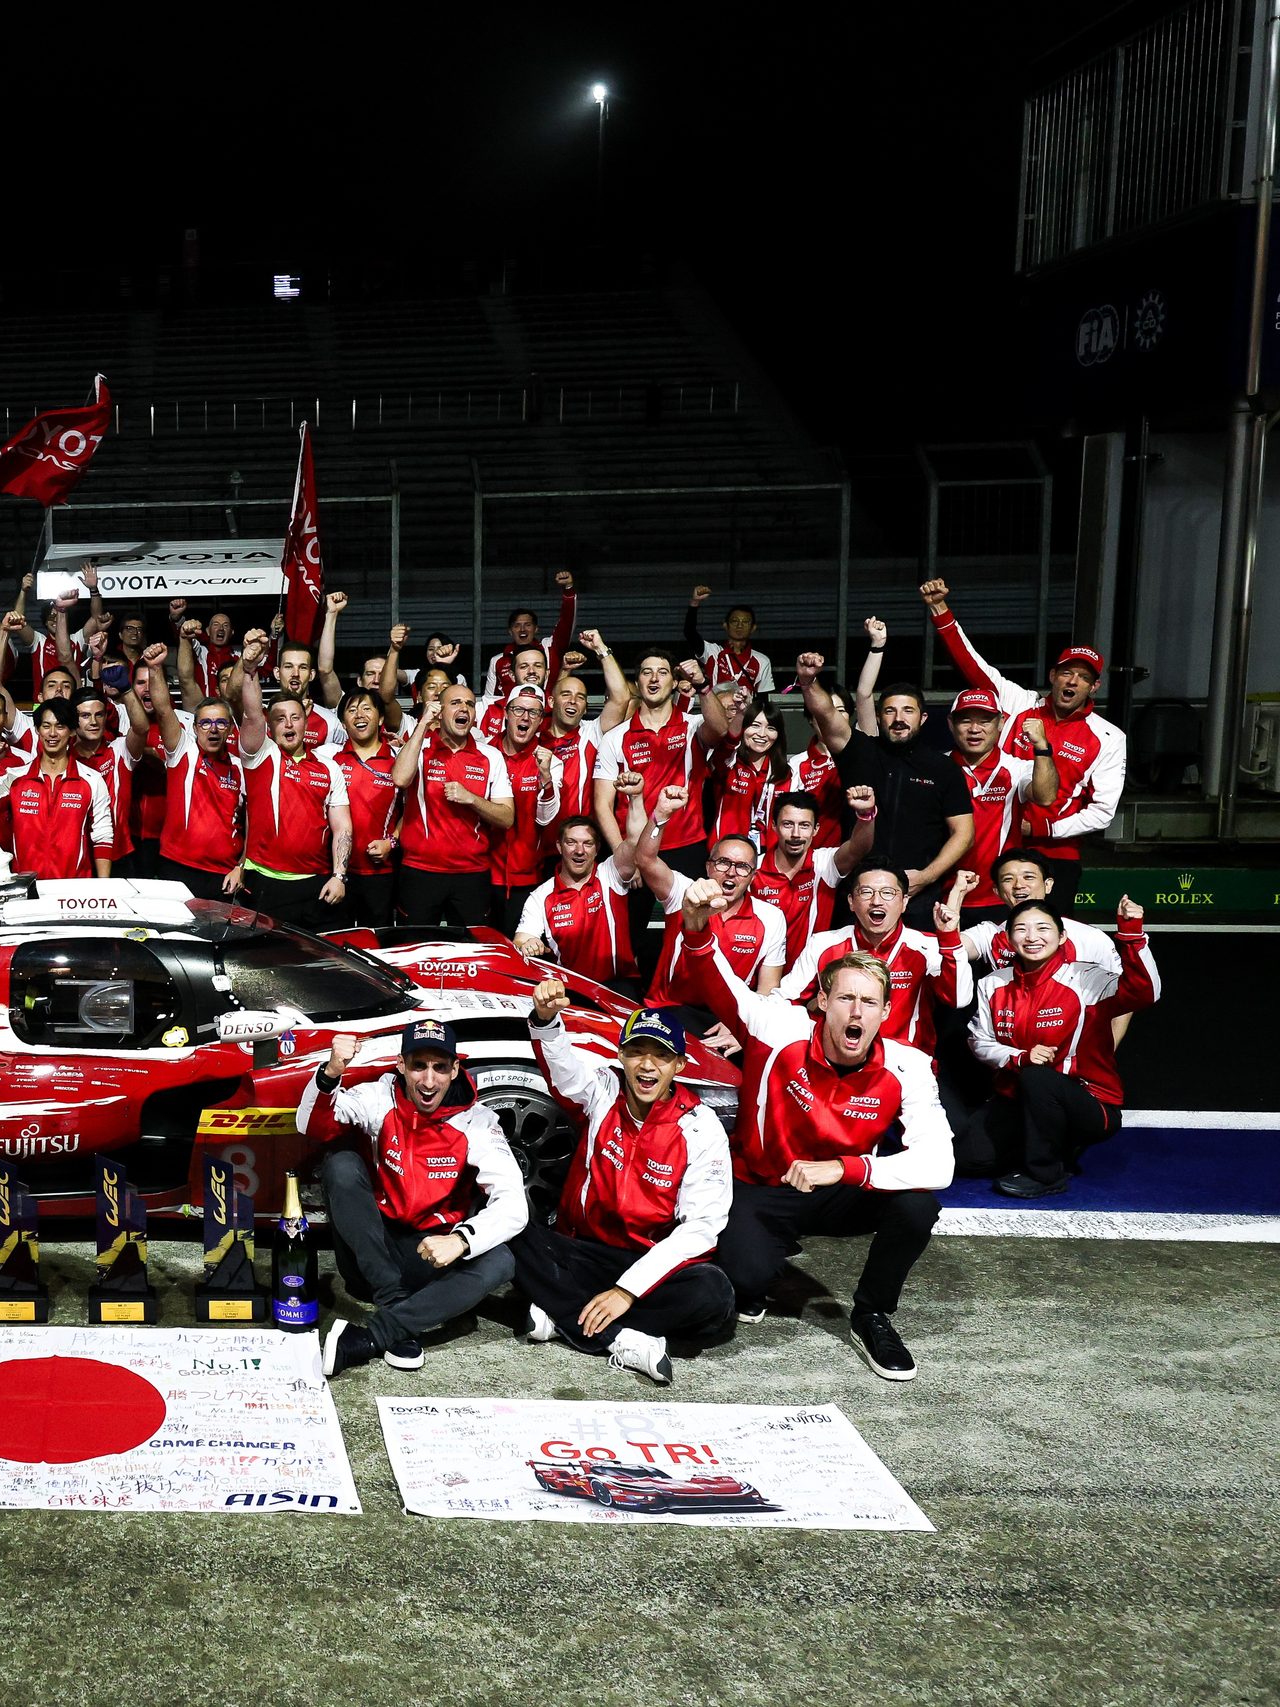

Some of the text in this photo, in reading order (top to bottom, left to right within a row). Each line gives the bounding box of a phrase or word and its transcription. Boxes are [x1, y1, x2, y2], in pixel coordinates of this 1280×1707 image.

[169, 577, 266, 586] RACING
[1070, 648, 1099, 660] TOYOTA
[962, 694, 989, 702] TOYOTA
[629, 741, 650, 751] FUJITSU
[1062, 740, 1086, 752] TOYOTA
[631, 750, 651, 758] AISIN
[1057, 751, 1082, 762] DENSO
[632, 758, 647, 766] Mobil
[465, 773, 485, 782] DENSO
[309, 780, 329, 788] DENSO
[373, 779, 394, 787] DENSO
[21, 788, 40, 799] FUJITSU
[20, 800, 39, 808] AISIN
[757, 886, 779, 896] FUJITSU
[1155, 893, 1214, 904] ROLEX
[57, 898, 117, 910] TOYOTA
[551, 903, 571, 913] FUJITSU
[734, 933, 757, 942] TOYOTA
[731, 946, 755, 954] DENSO
[417, 961, 478, 978] TOYOTA 8
[223, 1022, 274, 1035] DENSO
[632, 1018, 672, 1035] MICHELIN
[1036, 1019, 1064, 1029] DENSO
[414, 1031, 430, 1041] Red
[284, 1043, 292, 1053] N
[483, 1075, 534, 1084] PILOT SPORT
[790, 1080, 814, 1101] AISIN
[850, 1096, 881, 1106] TOYOTA
[843, 1108, 878, 1120] DENSO
[210, 1113, 290, 1129] DHL
[426, 1156, 457, 1164] TOYOTA
[646, 1158, 673, 1172] TOYOTA
[221, 1144, 260, 1198] 8
[427, 1171, 458, 1179] DENSO
[642, 1172, 673, 1188] DENSO
[104, 1167, 119, 1227] WEC
[210, 1165, 227, 1225] WEC
[388, 1405, 439, 1414] TOYOTA
[785, 1413, 832, 1424] FUJITSU
[627, 1440, 720, 1465] TR!
[225, 1490, 339, 1508] AISIN
